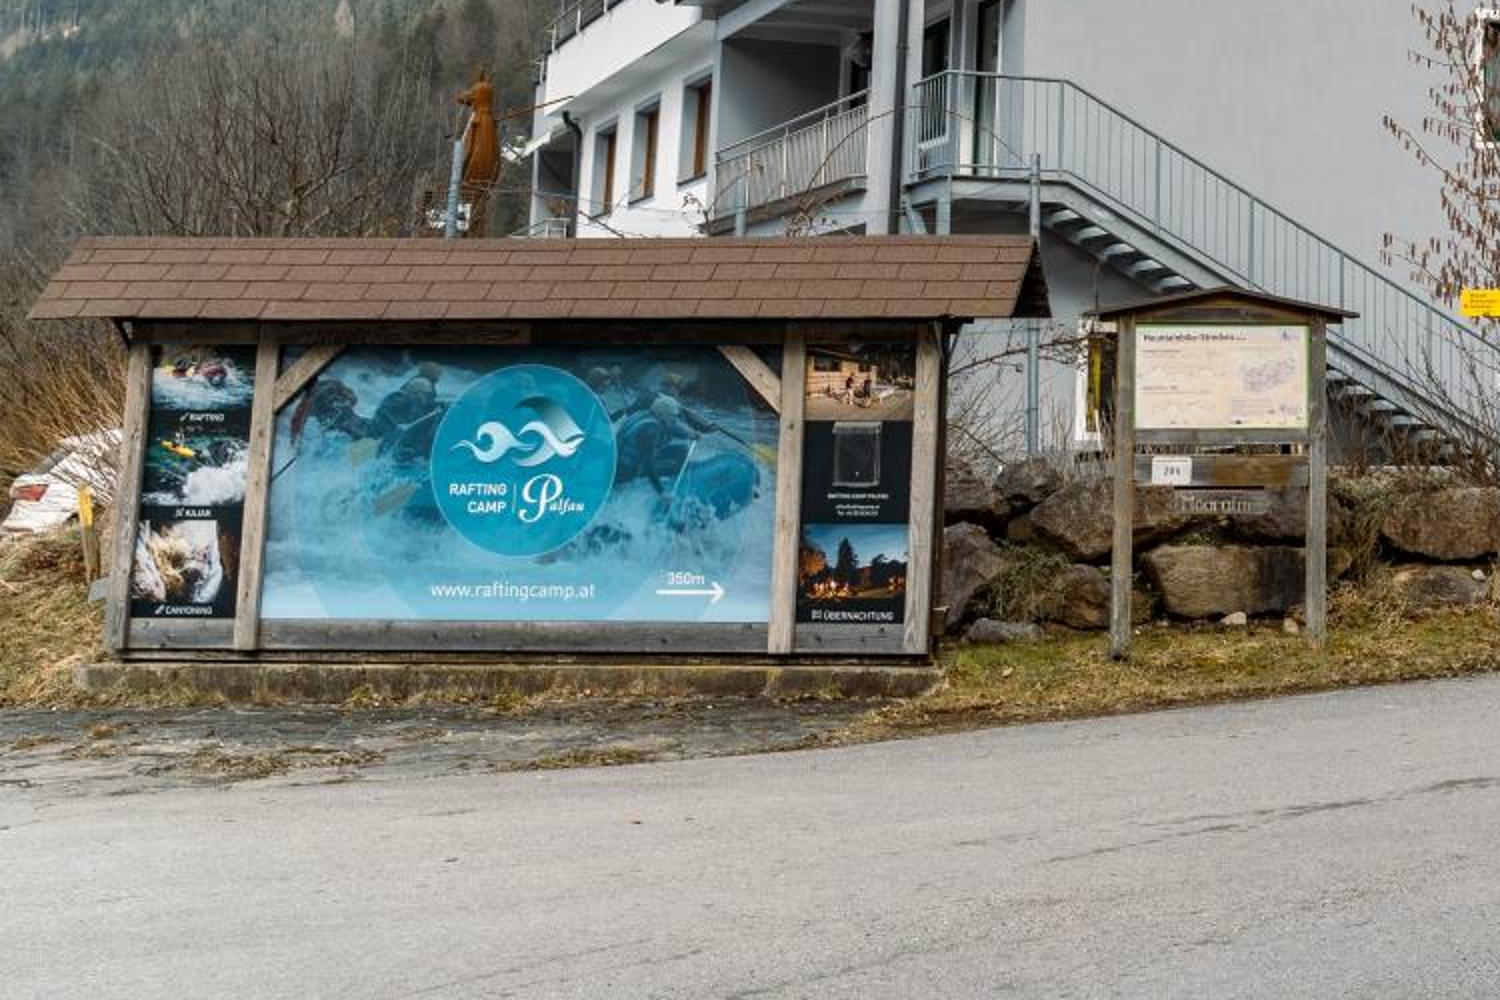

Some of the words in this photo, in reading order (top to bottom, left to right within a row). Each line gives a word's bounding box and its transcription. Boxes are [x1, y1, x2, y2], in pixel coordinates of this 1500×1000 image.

[448, 483, 508, 496] RAFTING
[518, 473, 585, 523] Palfau
[467, 501, 507, 513] CAMP
[666, 571, 705, 585] 350m
[430, 580, 596, 602] www.raftingcamp.at
